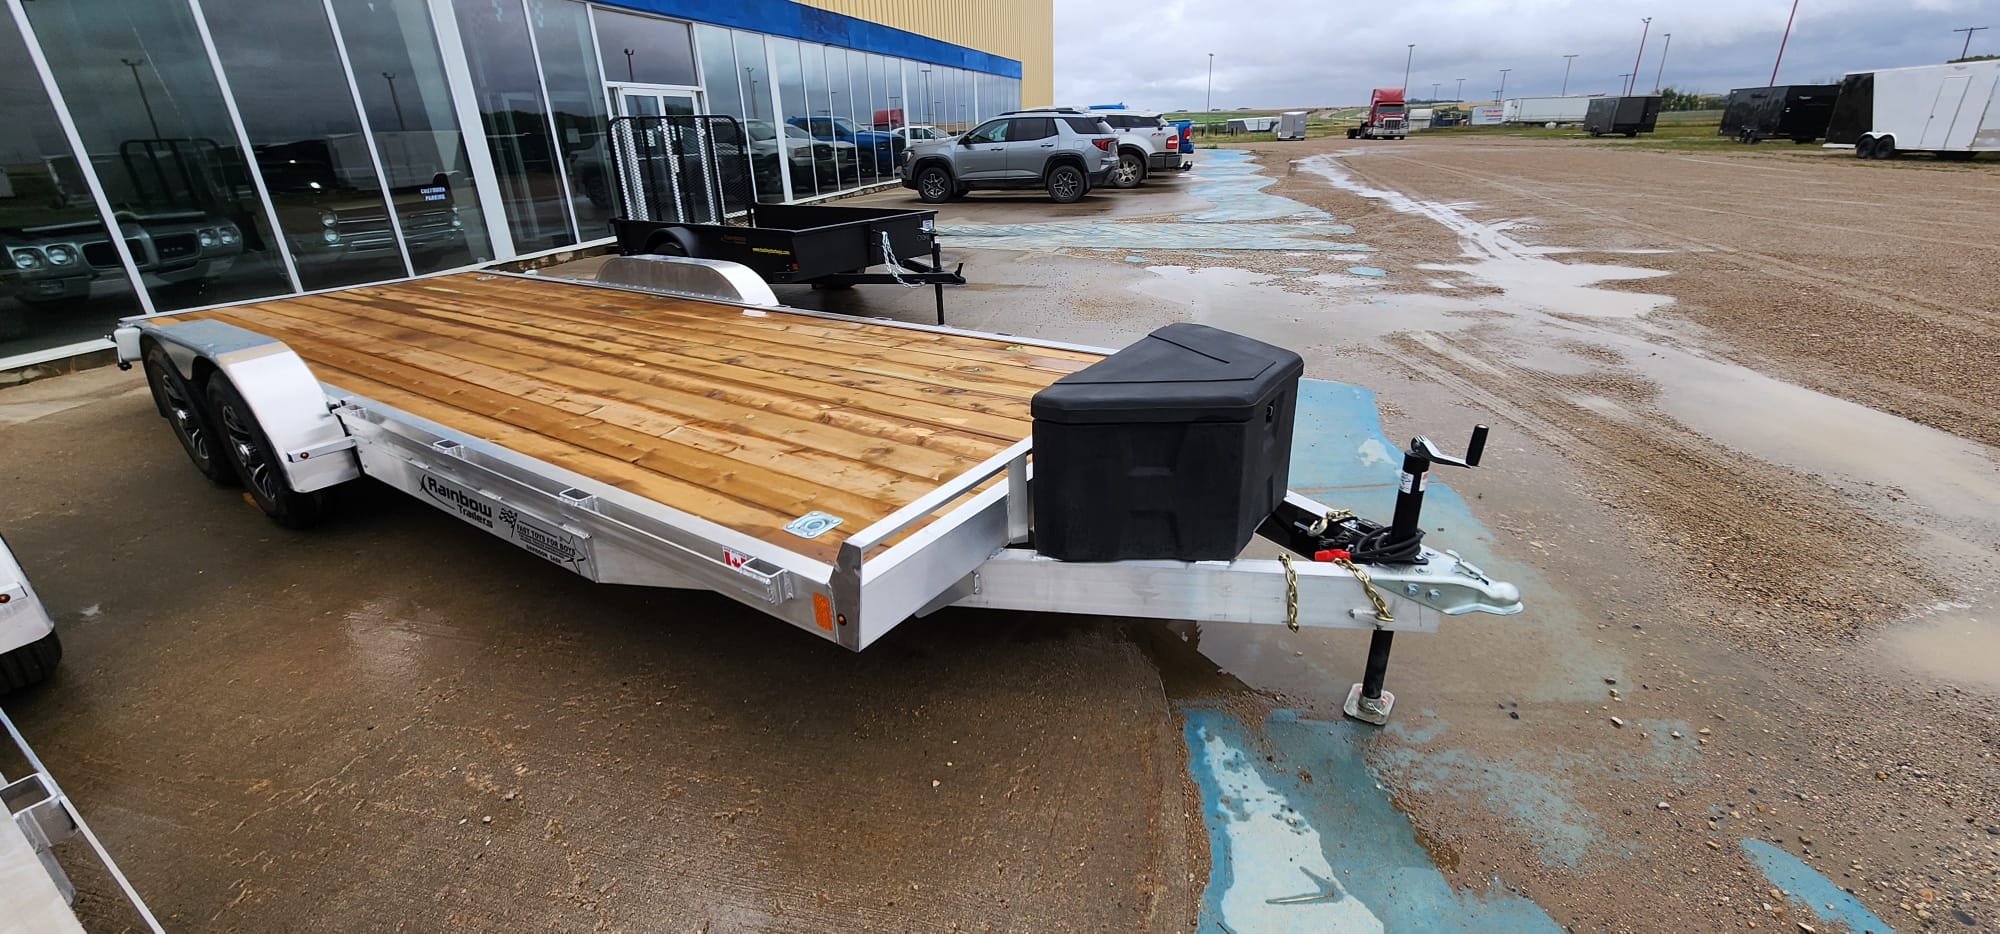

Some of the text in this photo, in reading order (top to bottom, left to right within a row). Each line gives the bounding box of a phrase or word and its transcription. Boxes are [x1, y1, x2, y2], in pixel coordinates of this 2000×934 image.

[427, 476, 493, 518] Rainbow
[457, 503, 494, 528] Trailers
[516, 524, 530, 535] FAST
[531, 529, 546, 542] TOYS
[547, 536, 559, 549] FOR
[559, 542, 576, 556] BOYS
